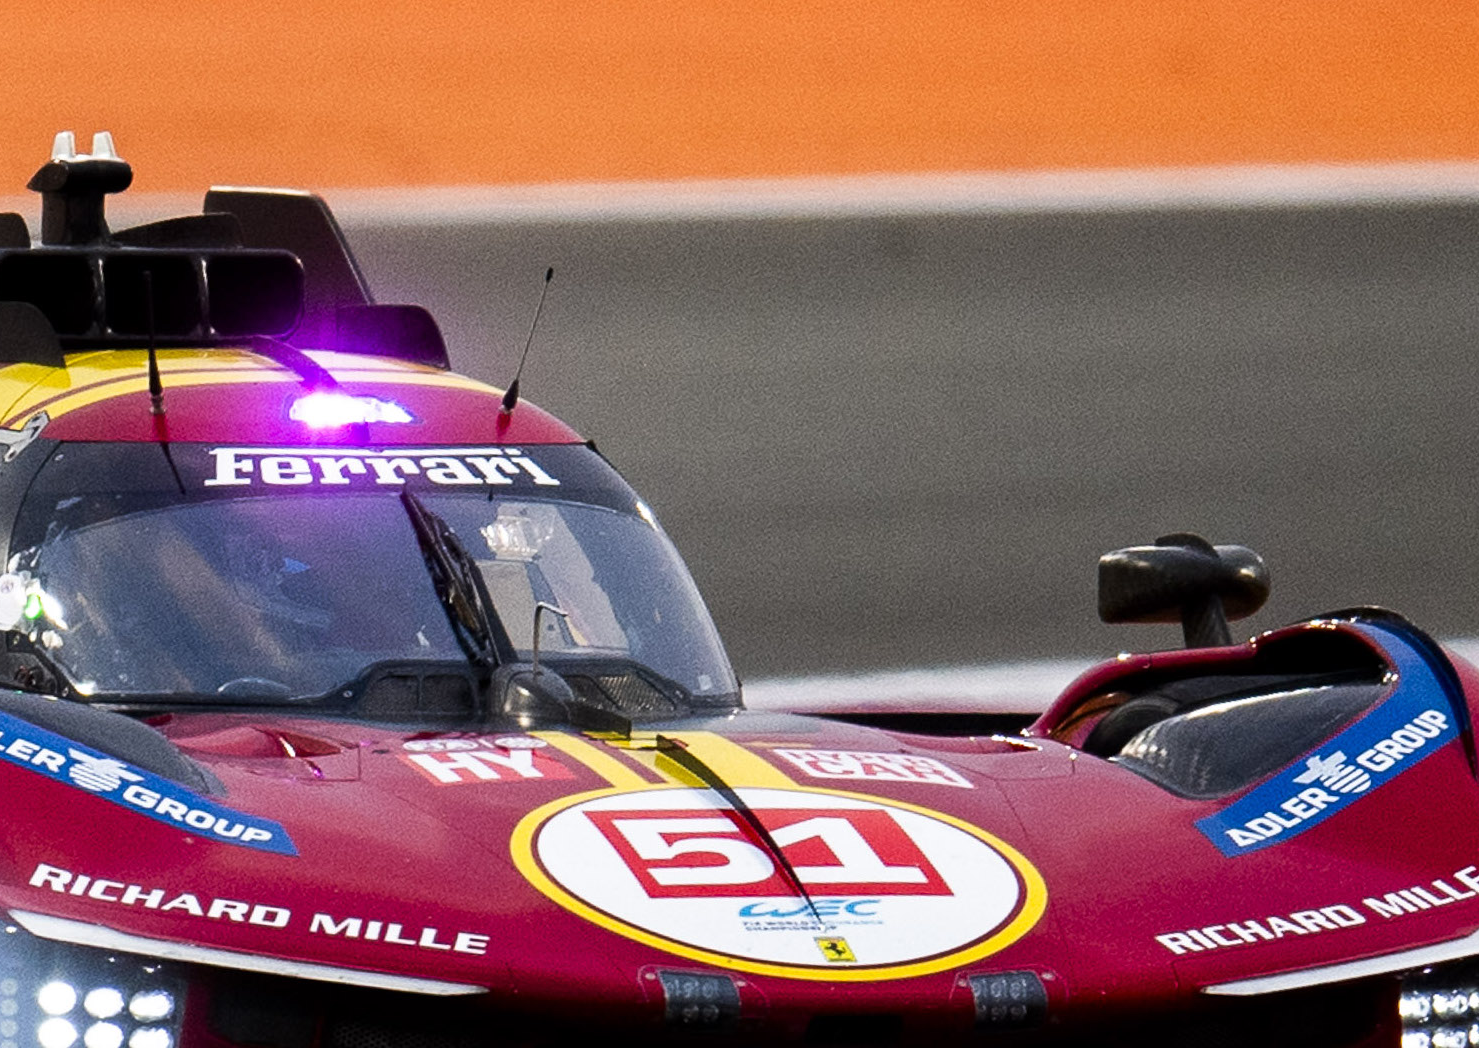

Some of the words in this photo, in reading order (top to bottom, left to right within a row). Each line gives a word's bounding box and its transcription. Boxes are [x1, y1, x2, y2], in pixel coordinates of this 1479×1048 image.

[205, 447, 560, 487] Ferrari
[408, 750, 545, 783] HY
[1225, 788, 1337, 850] ADLER
[1356, 709, 1449, 771] GROUP
[122, 784, 273, 846] GROUP
[614, 816, 930, 886] 51
[28, 864, 291, 930] RICHARD
[309, 912, 492, 956] MILLE
[738, 899, 882, 918] WEC
[1156, 904, 1364, 956] RICHARD
